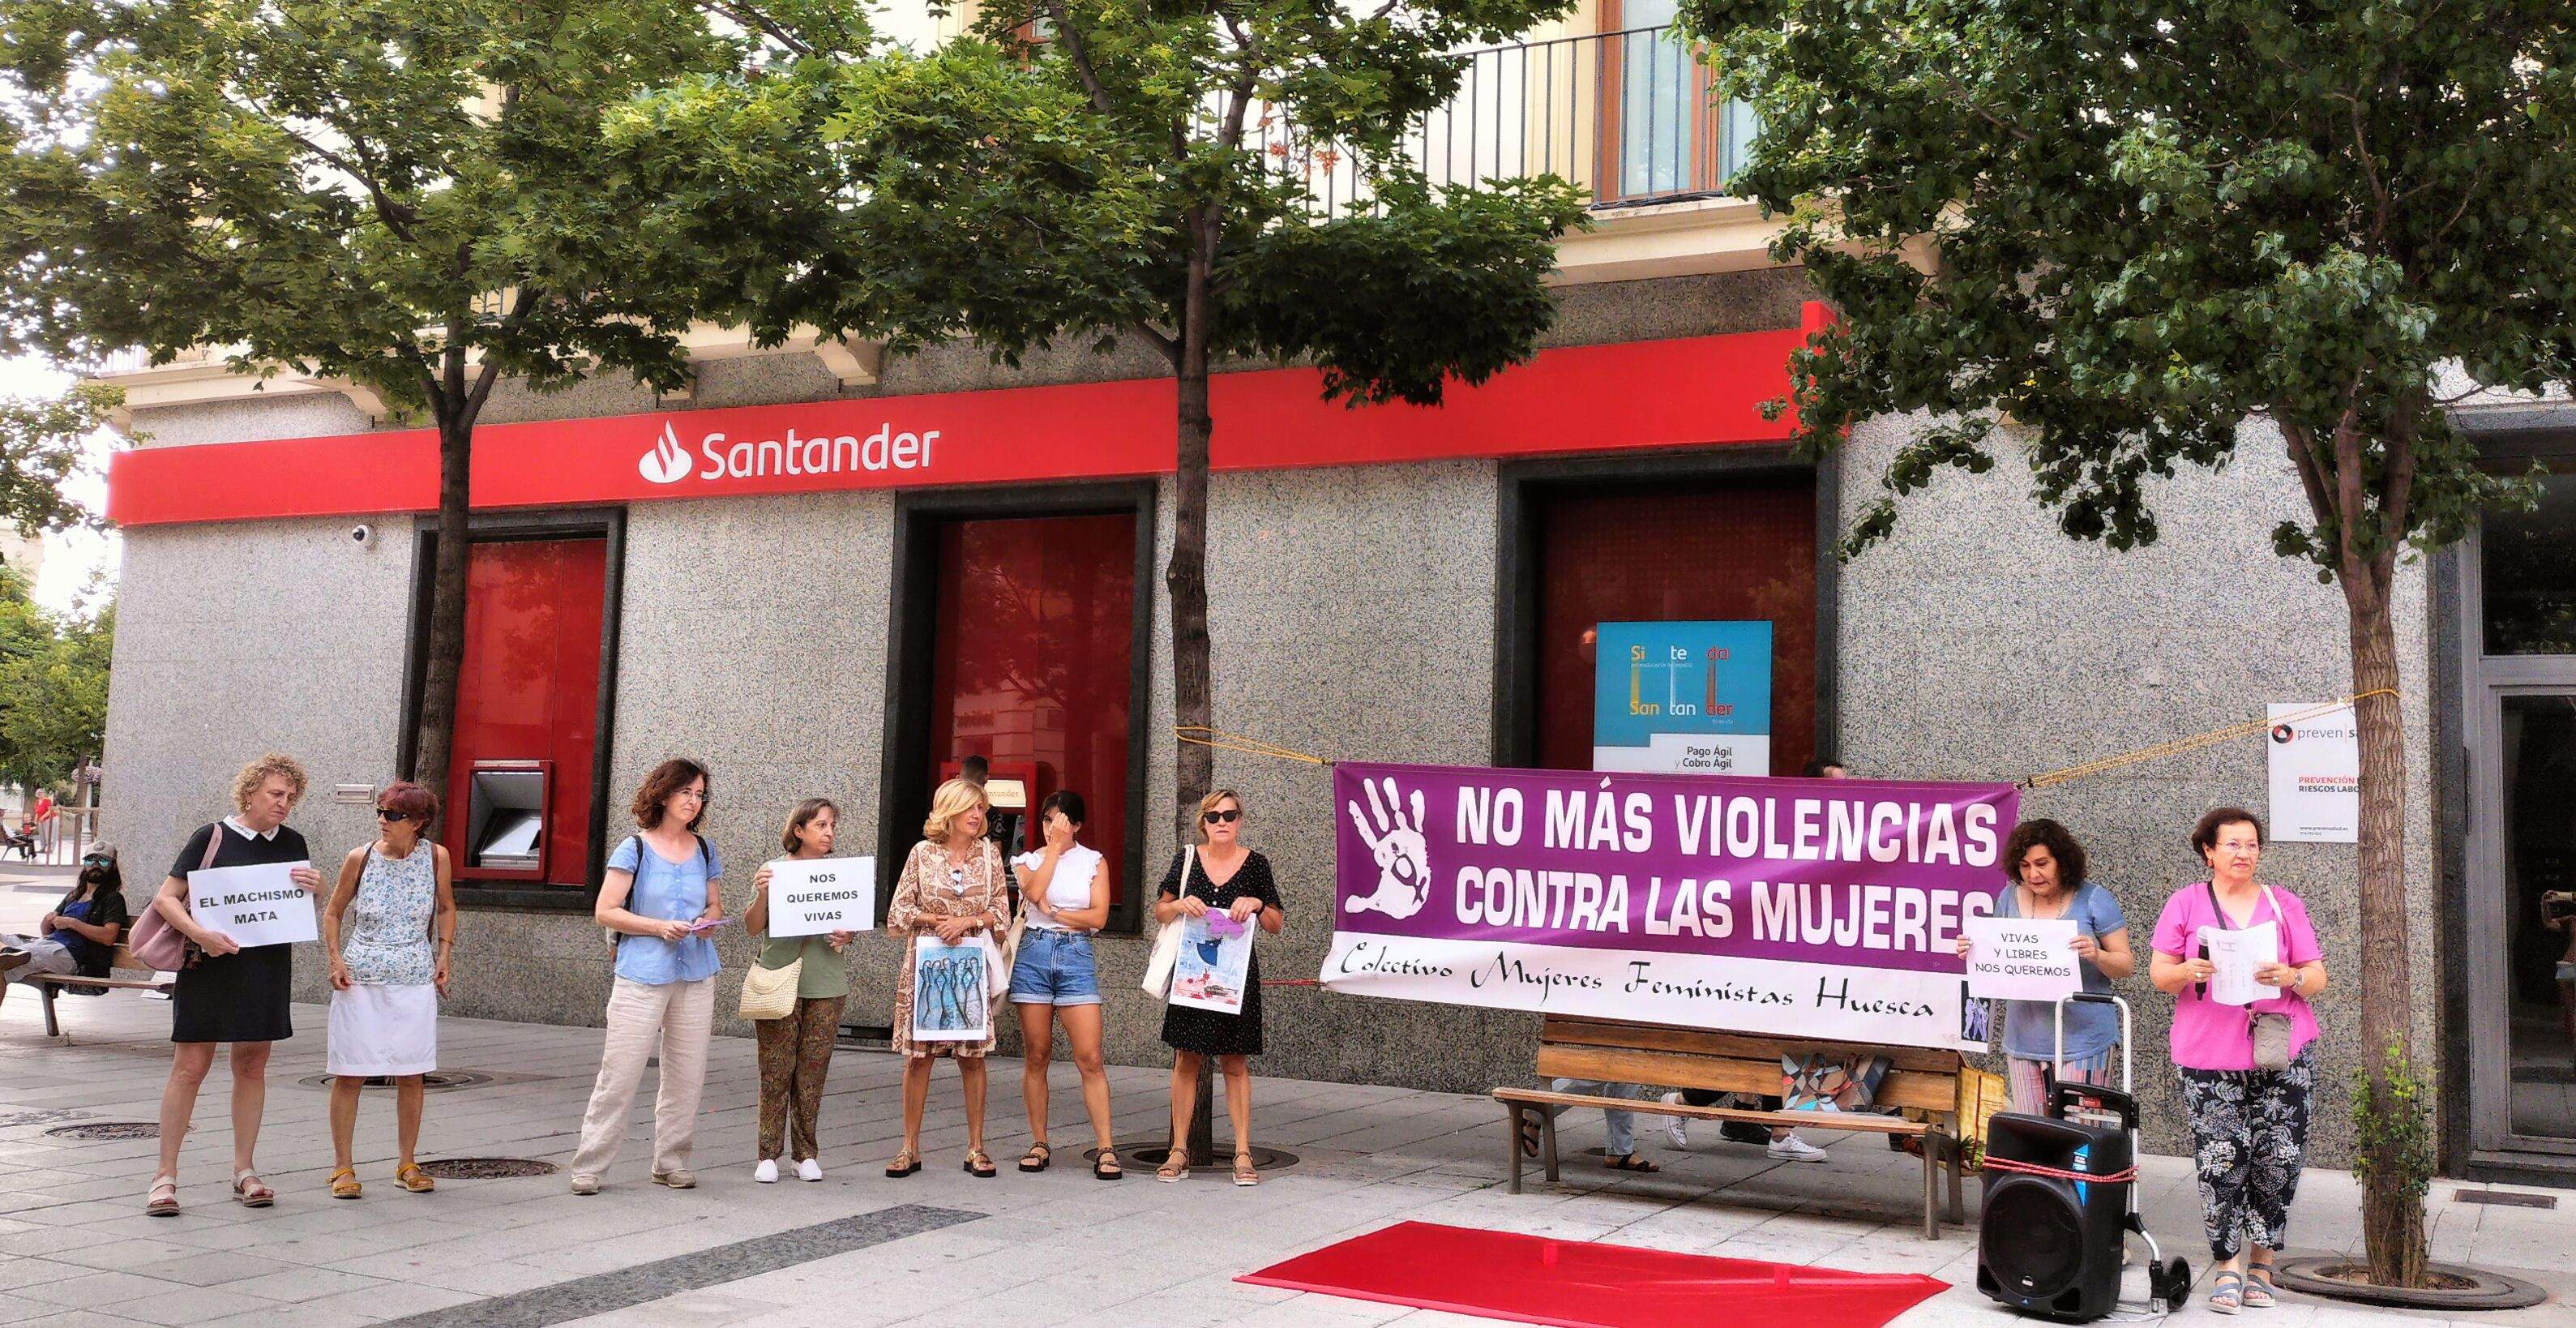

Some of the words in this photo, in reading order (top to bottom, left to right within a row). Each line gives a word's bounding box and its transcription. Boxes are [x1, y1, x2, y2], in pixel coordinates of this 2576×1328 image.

[700, 422, 940, 481] Santander
[1630, 645, 1645, 660] Si
[1670, 645, 1688, 660] te
[1706, 645, 1730, 661] da
[1629, 700, 1661, 715] San
[1669, 701, 1697, 716] tan
[1705, 701, 1734, 716] der
[2297, 729, 2343, 741] preven
[1687, 746, 1711, 758] Pago
[1713, 744, 1732, 759] Ágil
[1675, 760, 1680, 769] y
[1683, 757, 1711, 768] Cobro
[1713, 756, 1732, 770] Ágil
[2298, 775, 2355, 784] PREVENCIÓN
[1457, 786, 1524, 846] NO
[1544, 775, 1653, 853] MÁS
[1674, 794, 1997, 867] VIOLENCIAS
[810, 873, 837, 883] NOS
[199, 897, 219, 908] EL
[224, 889, 305, 906] MACHISMO
[787, 890, 858, 903] QUEREMOS
[1456, 866, 1629, 932] CONTRA
[1645, 876, 1734, 939] LAS
[234, 910, 278, 924] MATA
[804, 910, 842, 922] VIVAS
[2000, 933, 2039, 944] VIVAS
[1994, 948, 2000, 957] Y
[2006, 949, 2048, 960] LIBRES
[1975, 962, 2000, 973] NOS
[2005, 964, 2071, 976] QUEREMOS
[1341, 941, 1453, 978] Colectivo
[1471, 950, 1603, 1007] Mujeres
[1624, 961, 1794, 1005] Feministas
[1816, 975, 1935, 1017] Huesca
